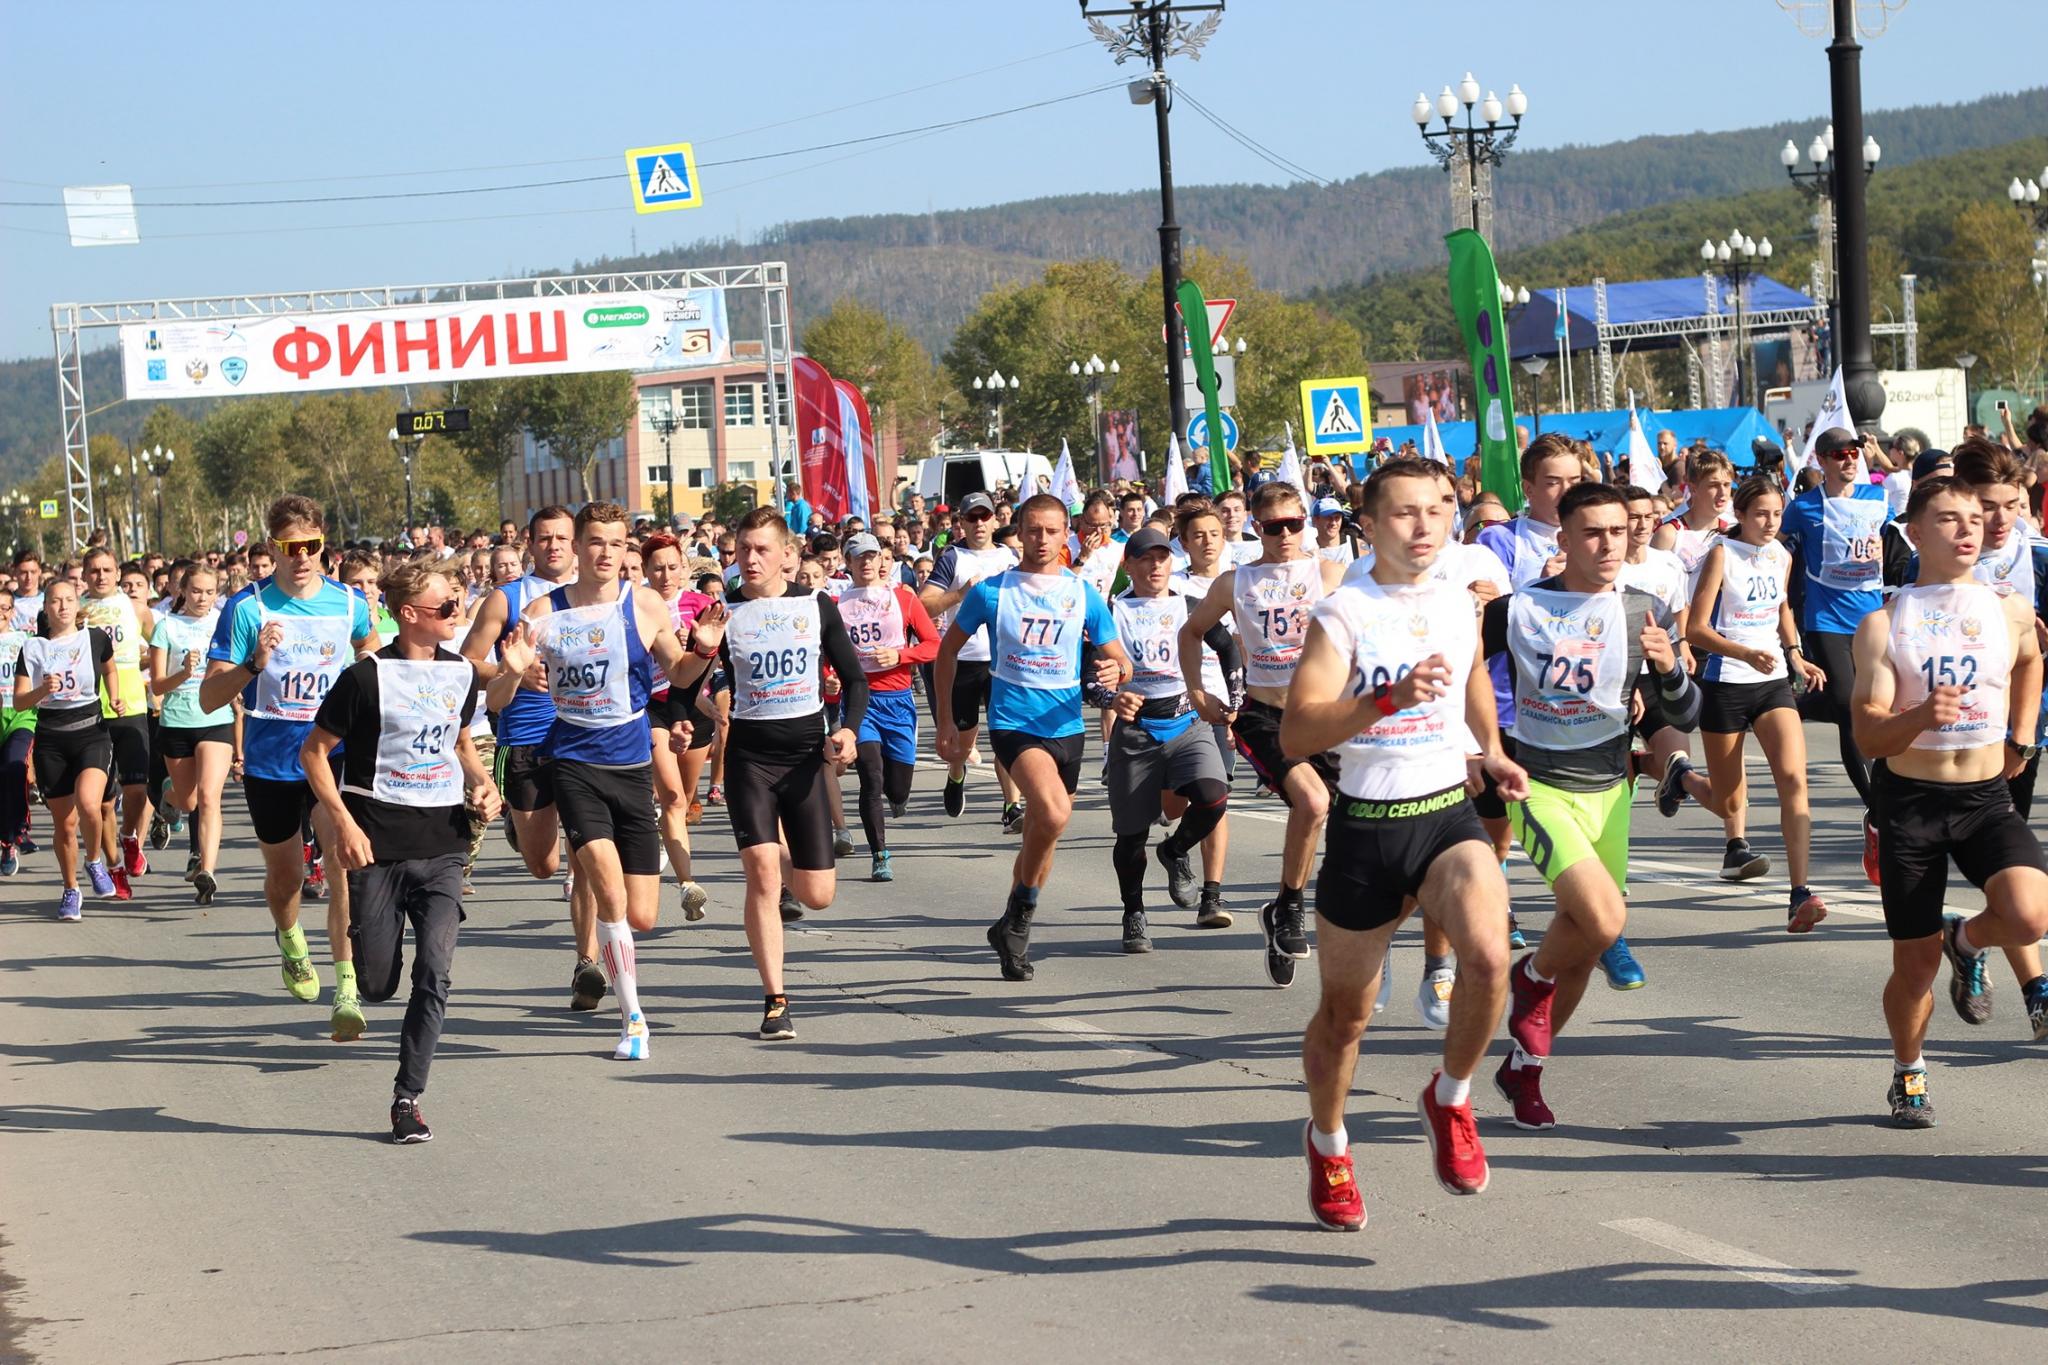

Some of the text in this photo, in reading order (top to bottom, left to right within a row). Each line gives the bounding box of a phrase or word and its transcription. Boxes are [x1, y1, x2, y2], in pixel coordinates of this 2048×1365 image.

[272, 310, 569, 380] ФИНИШ
[1746, 575, 1778, 601] 203
[850, 621, 882, 645] 655
[1022, 617, 1066, 645] 777
[556, 659, 610, 689] 2067
[749, 647, 808, 680] 2063
[1536, 653, 1594, 694] 725
[1921, 654, 1977, 693] 152
[280, 671, 330, 700] 1120
[1521, 697, 1549, 712] КРОСС
[1347, 801, 1387, 819] ODLO
